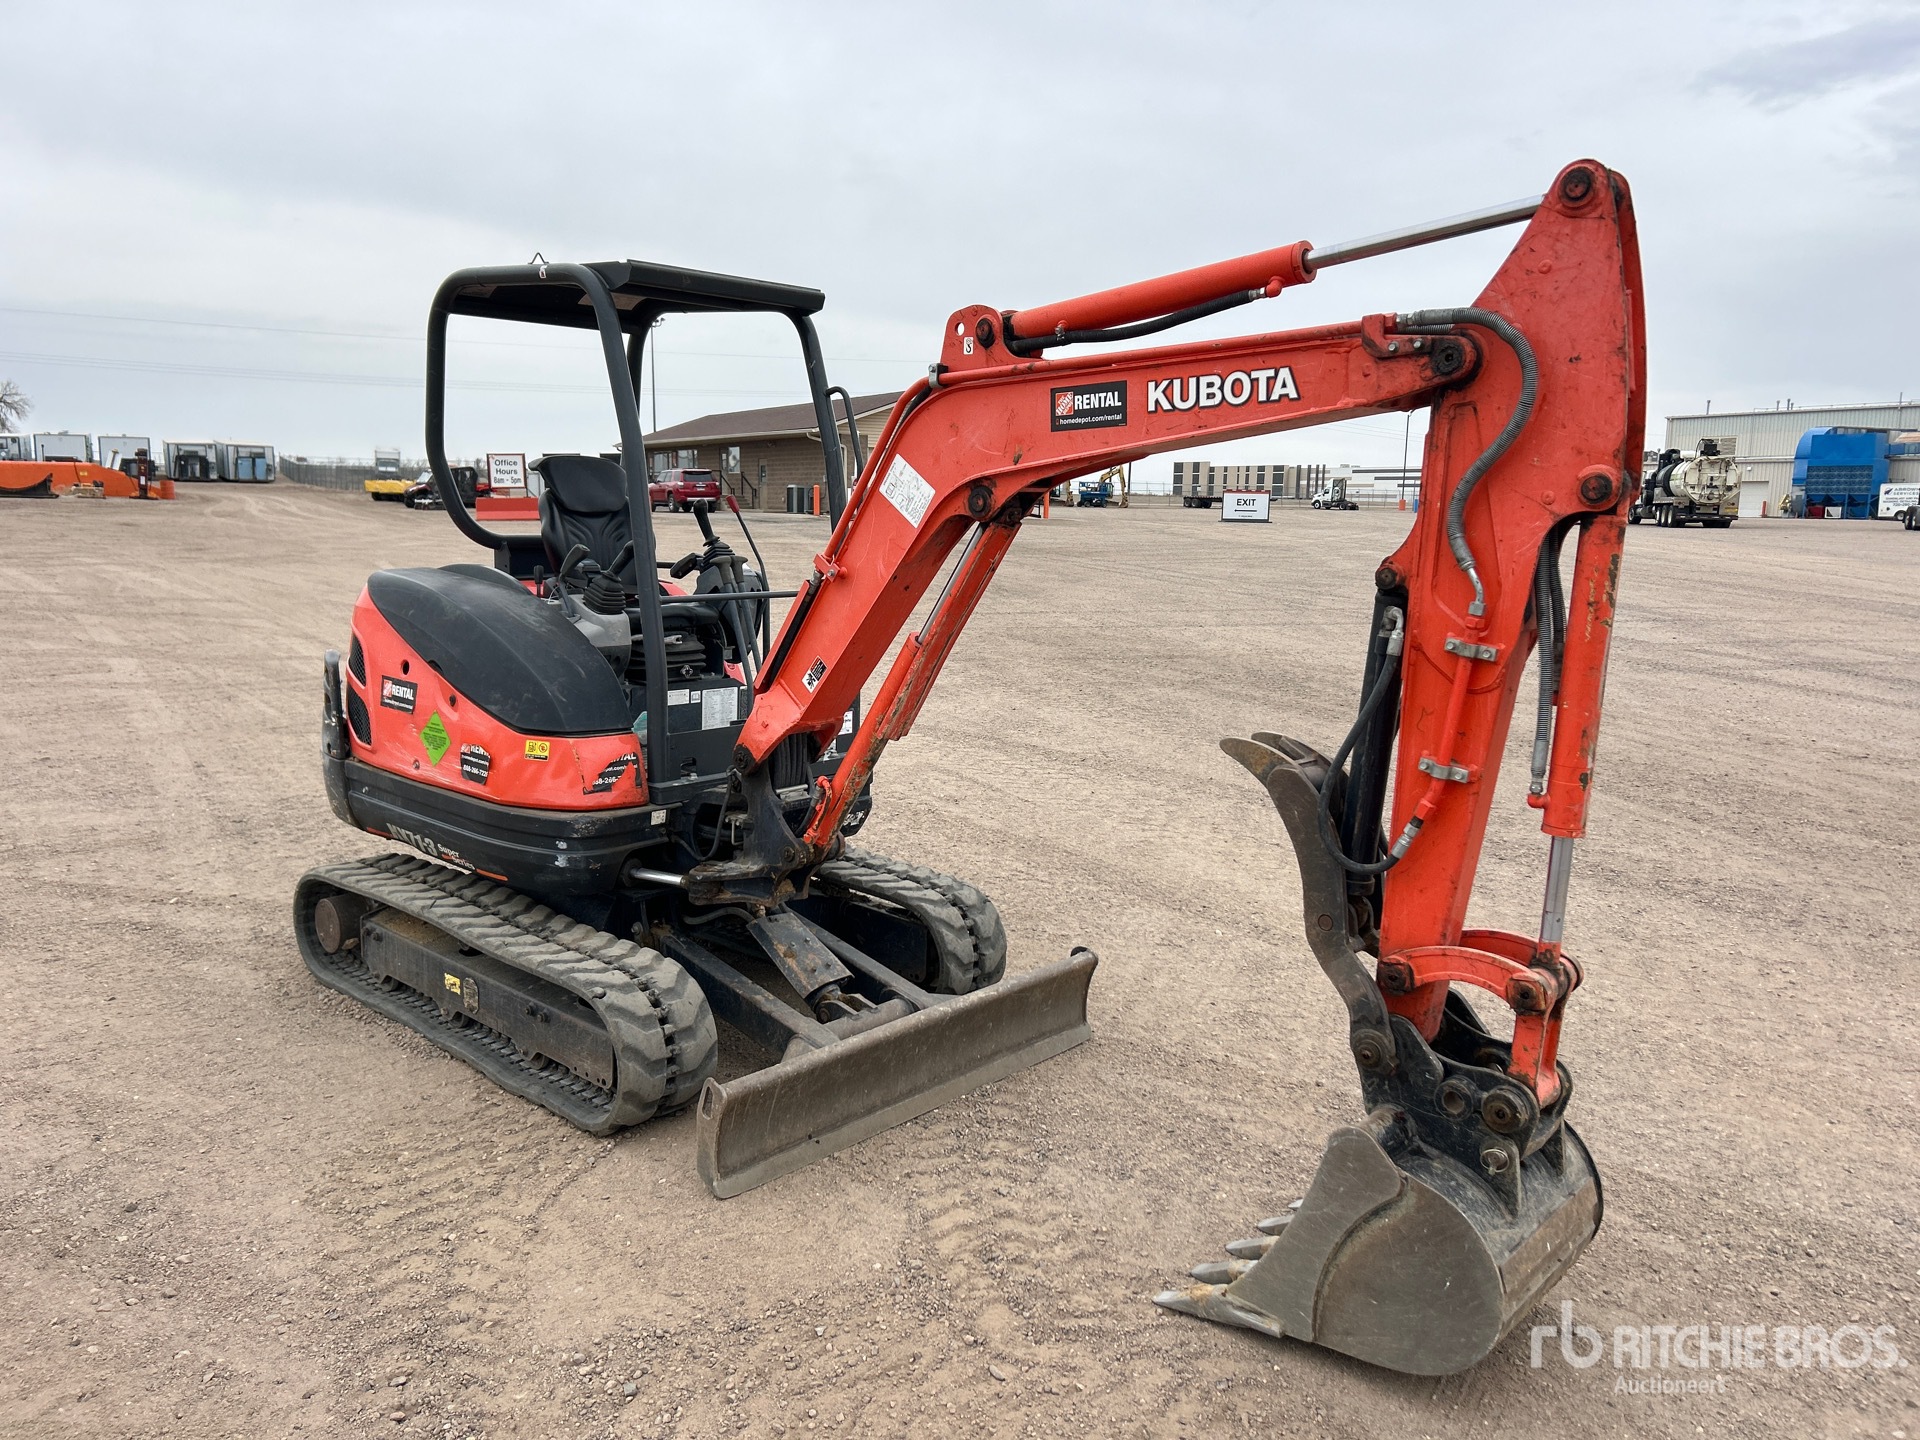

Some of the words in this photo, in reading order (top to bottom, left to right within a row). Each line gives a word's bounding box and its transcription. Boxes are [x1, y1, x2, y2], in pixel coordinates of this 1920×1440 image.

[1147, 367, 1298, 412] KUBOTA
[1074, 391, 1122, 410] RENTAL
[1060, 413, 1122, 425] homedepot.com/rental
[392, 684, 414, 700] RENTAL
[437, 843, 460, 858] Super
